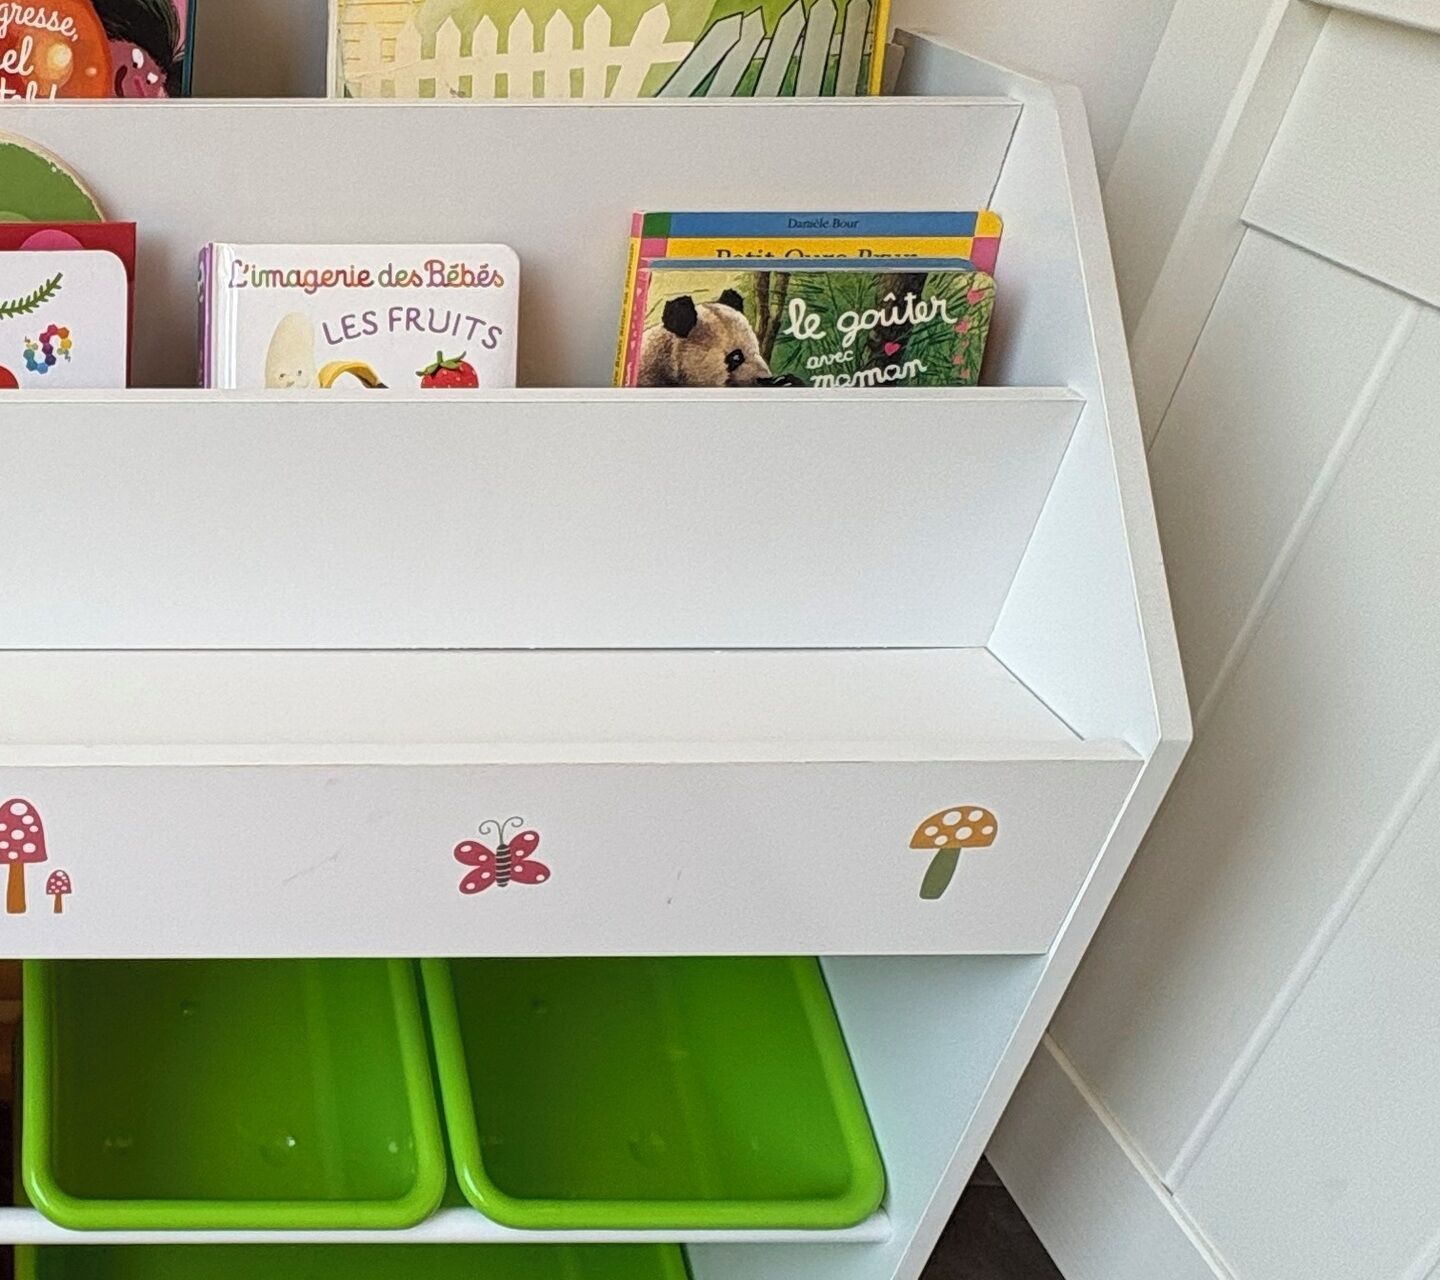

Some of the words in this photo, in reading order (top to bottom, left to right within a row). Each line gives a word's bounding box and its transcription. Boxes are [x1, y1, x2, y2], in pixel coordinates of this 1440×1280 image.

[832, 217, 860, 229] Bour
[228, 259, 375, 294] L'imagerie
[378, 263, 423, 288] des
[424, 259, 505, 289] Bébés
[322, 310, 379, 345] LES
[388, 307, 503, 350] FRUITS
[783, 298, 826, 340] le
[836, 292, 958, 347] goûter
[805, 350, 854, 369] avec
[810, 359, 928, 388] maman
